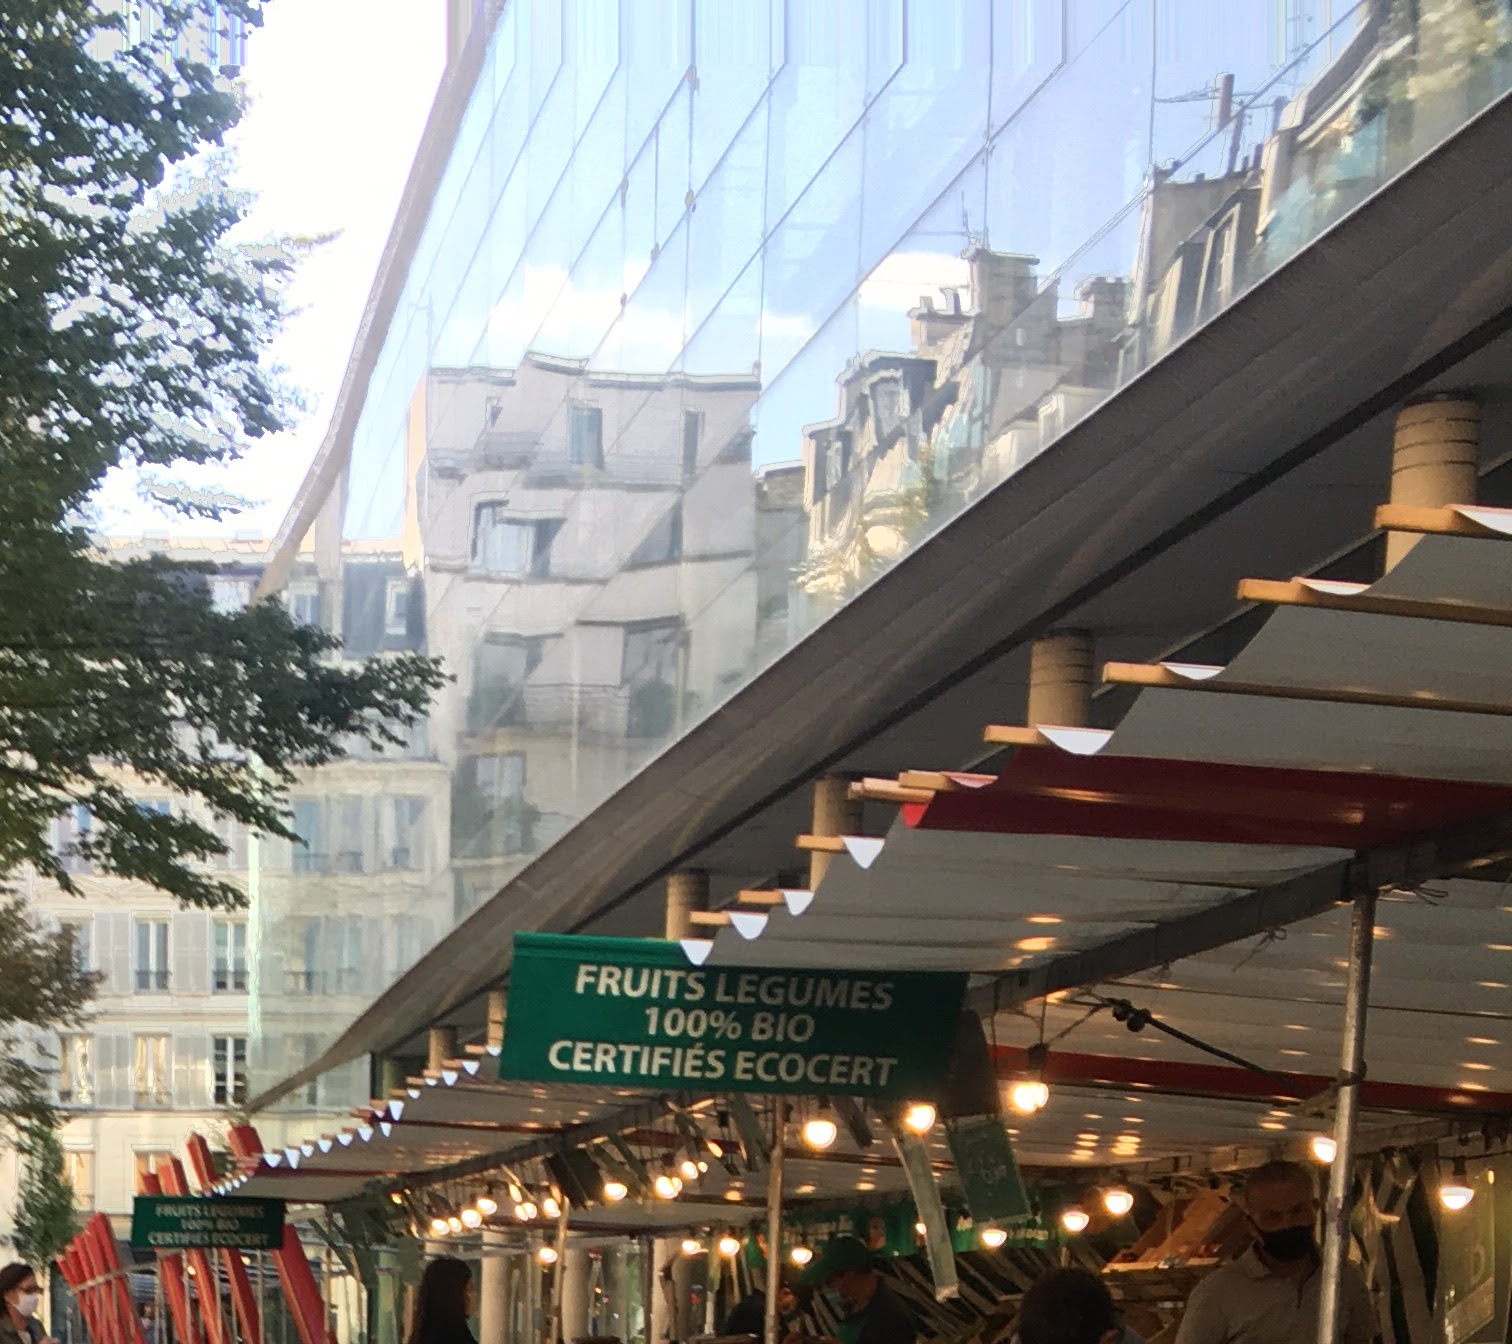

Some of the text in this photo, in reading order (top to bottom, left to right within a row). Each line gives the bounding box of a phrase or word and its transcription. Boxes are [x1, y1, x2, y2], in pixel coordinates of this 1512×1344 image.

[575, 965, 894, 1011] FRUITS LEGUMES
[645, 1007, 815, 1043] 100% BIO
[548, 1040, 898, 1086] CERTIFIÉS ECOCERT
[155, 1203, 202, 1217] FRUITS
